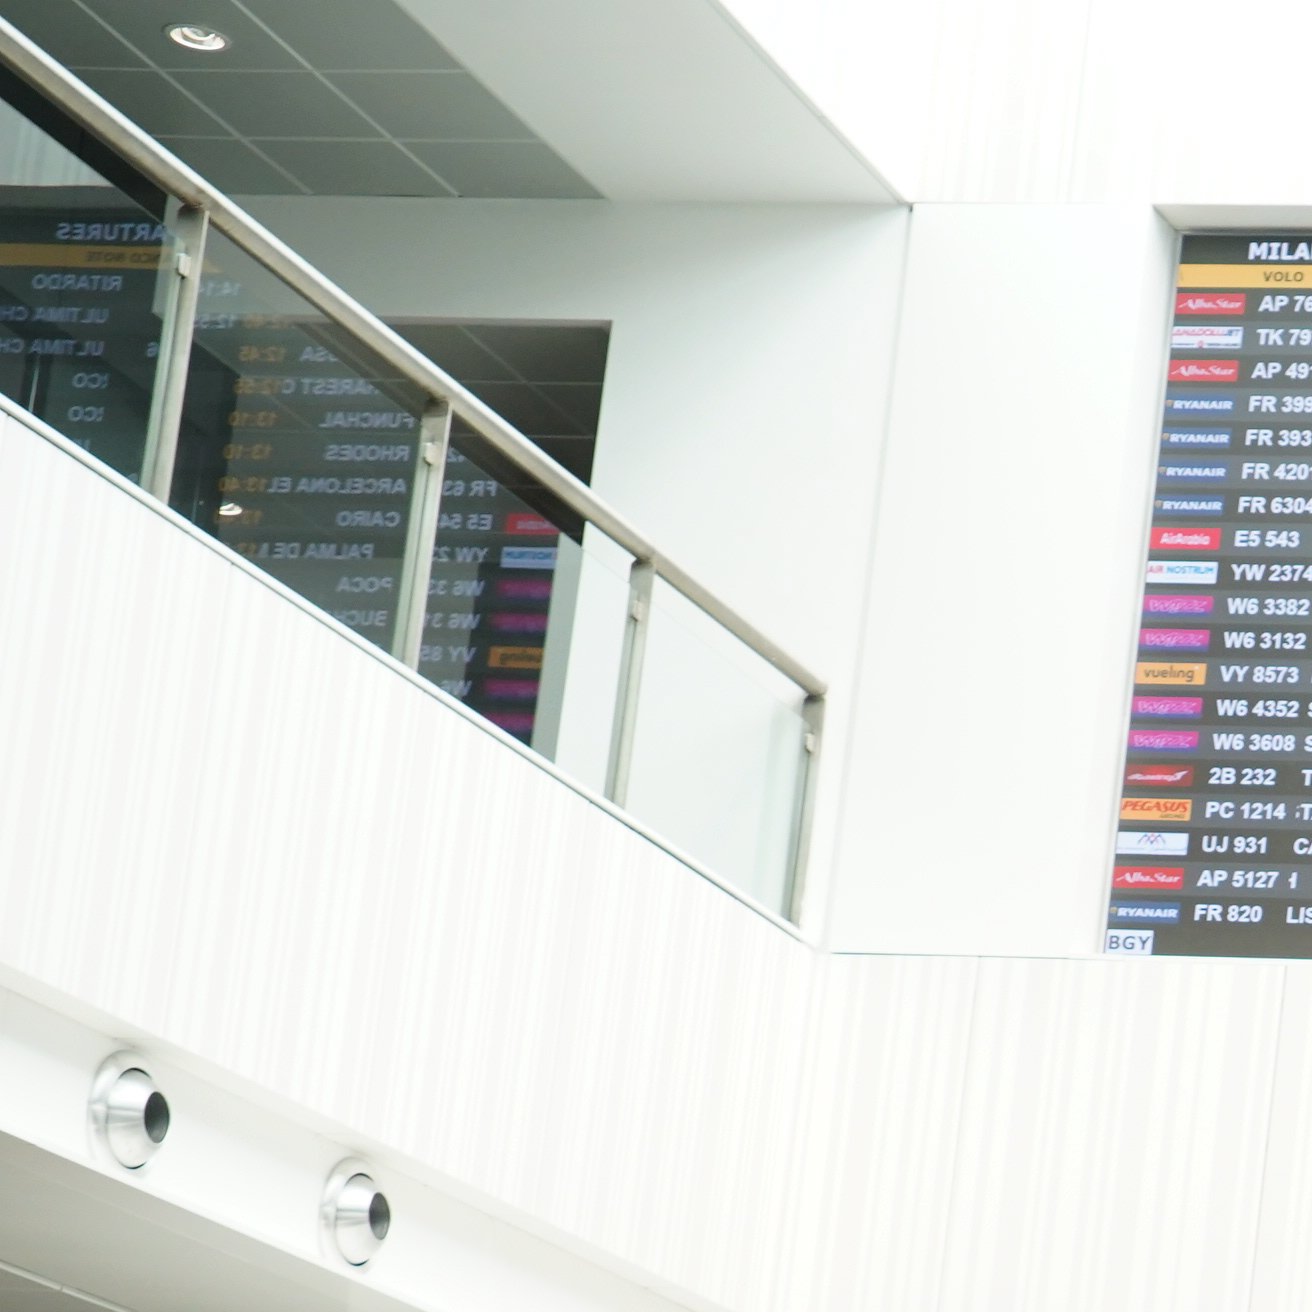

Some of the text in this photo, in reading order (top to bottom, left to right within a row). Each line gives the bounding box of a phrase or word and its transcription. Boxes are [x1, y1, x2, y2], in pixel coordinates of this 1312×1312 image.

[1263, 271, 1304, 282] VOLO
[1259, 296, 1289, 311] AP
[1209, 768, 1235, 784] 2B
[1241, 769, 1275, 785] 232
[1109, 935, 1150, 949] BGY
